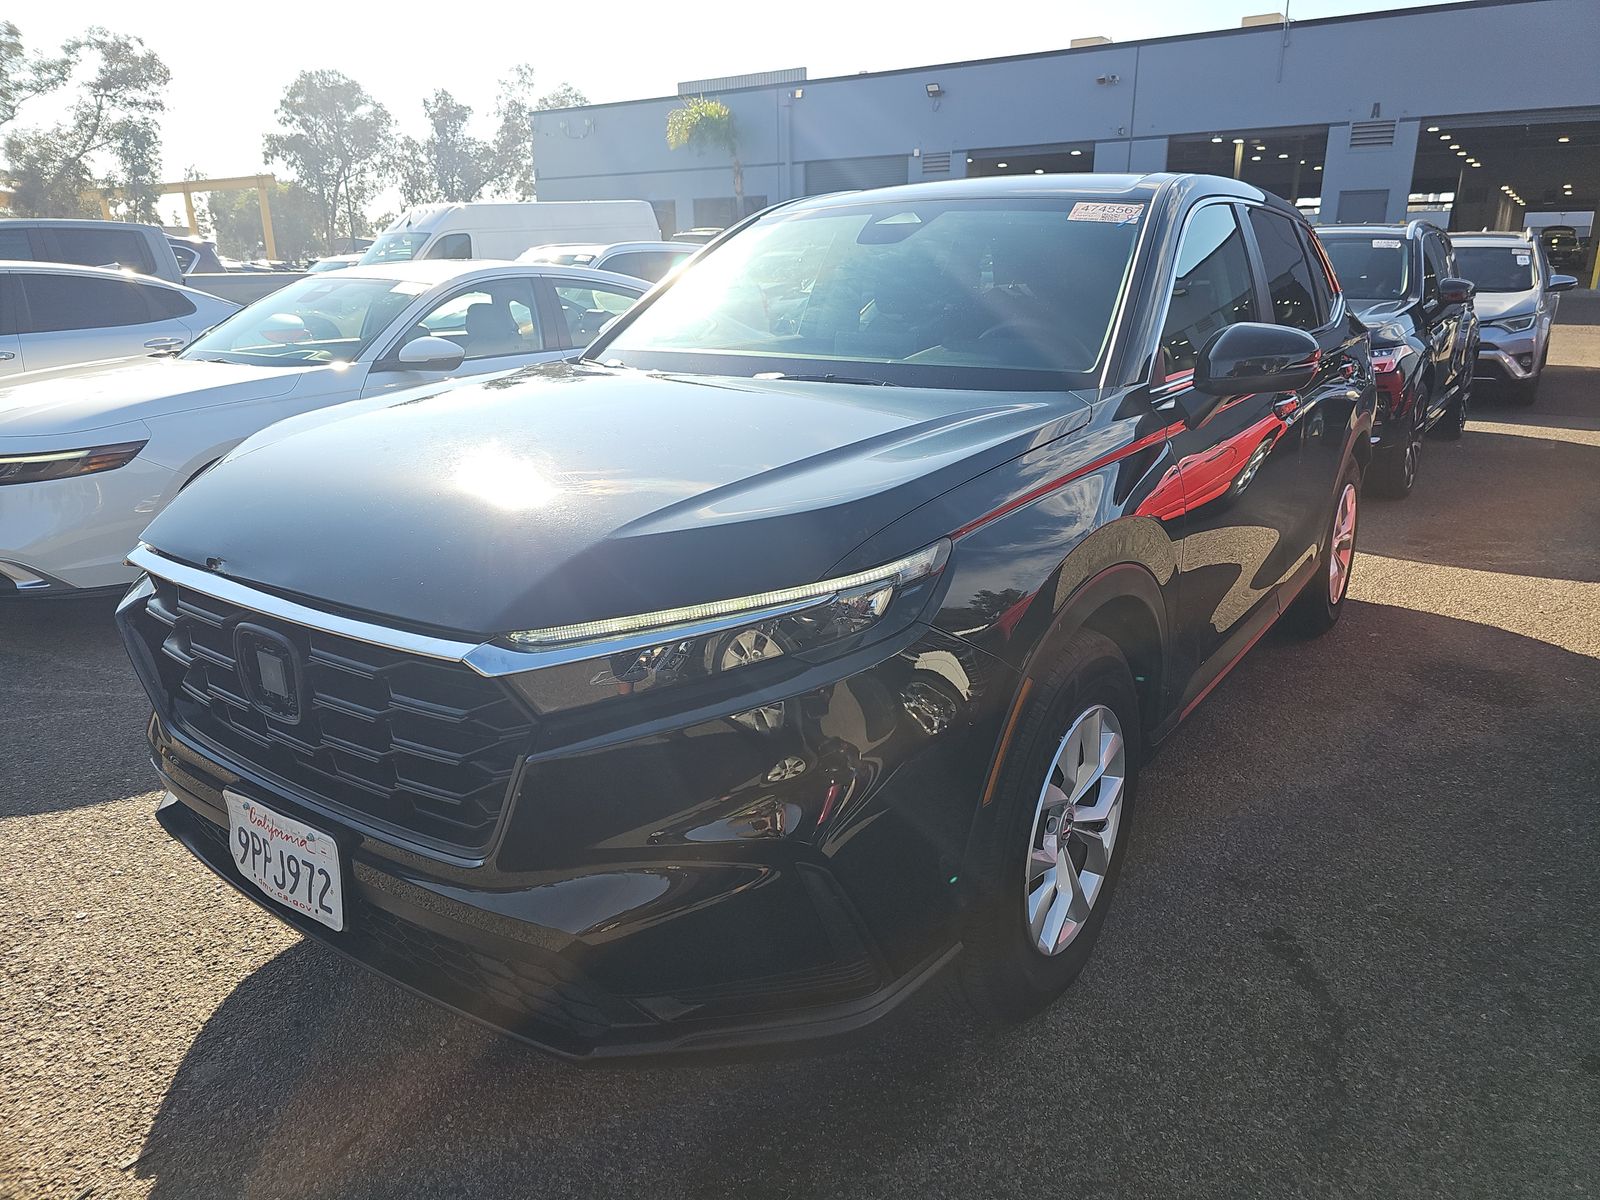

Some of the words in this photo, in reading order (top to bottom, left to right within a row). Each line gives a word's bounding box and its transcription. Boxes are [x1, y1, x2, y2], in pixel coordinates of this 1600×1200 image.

[1370, 102, 1381, 119] A
[1081, 204, 1143, 215] 4745567
[249, 806, 316, 855] California
[238, 826, 333, 915] 9PPJ972
[258, 877, 312, 912] dmv.ca.gov
